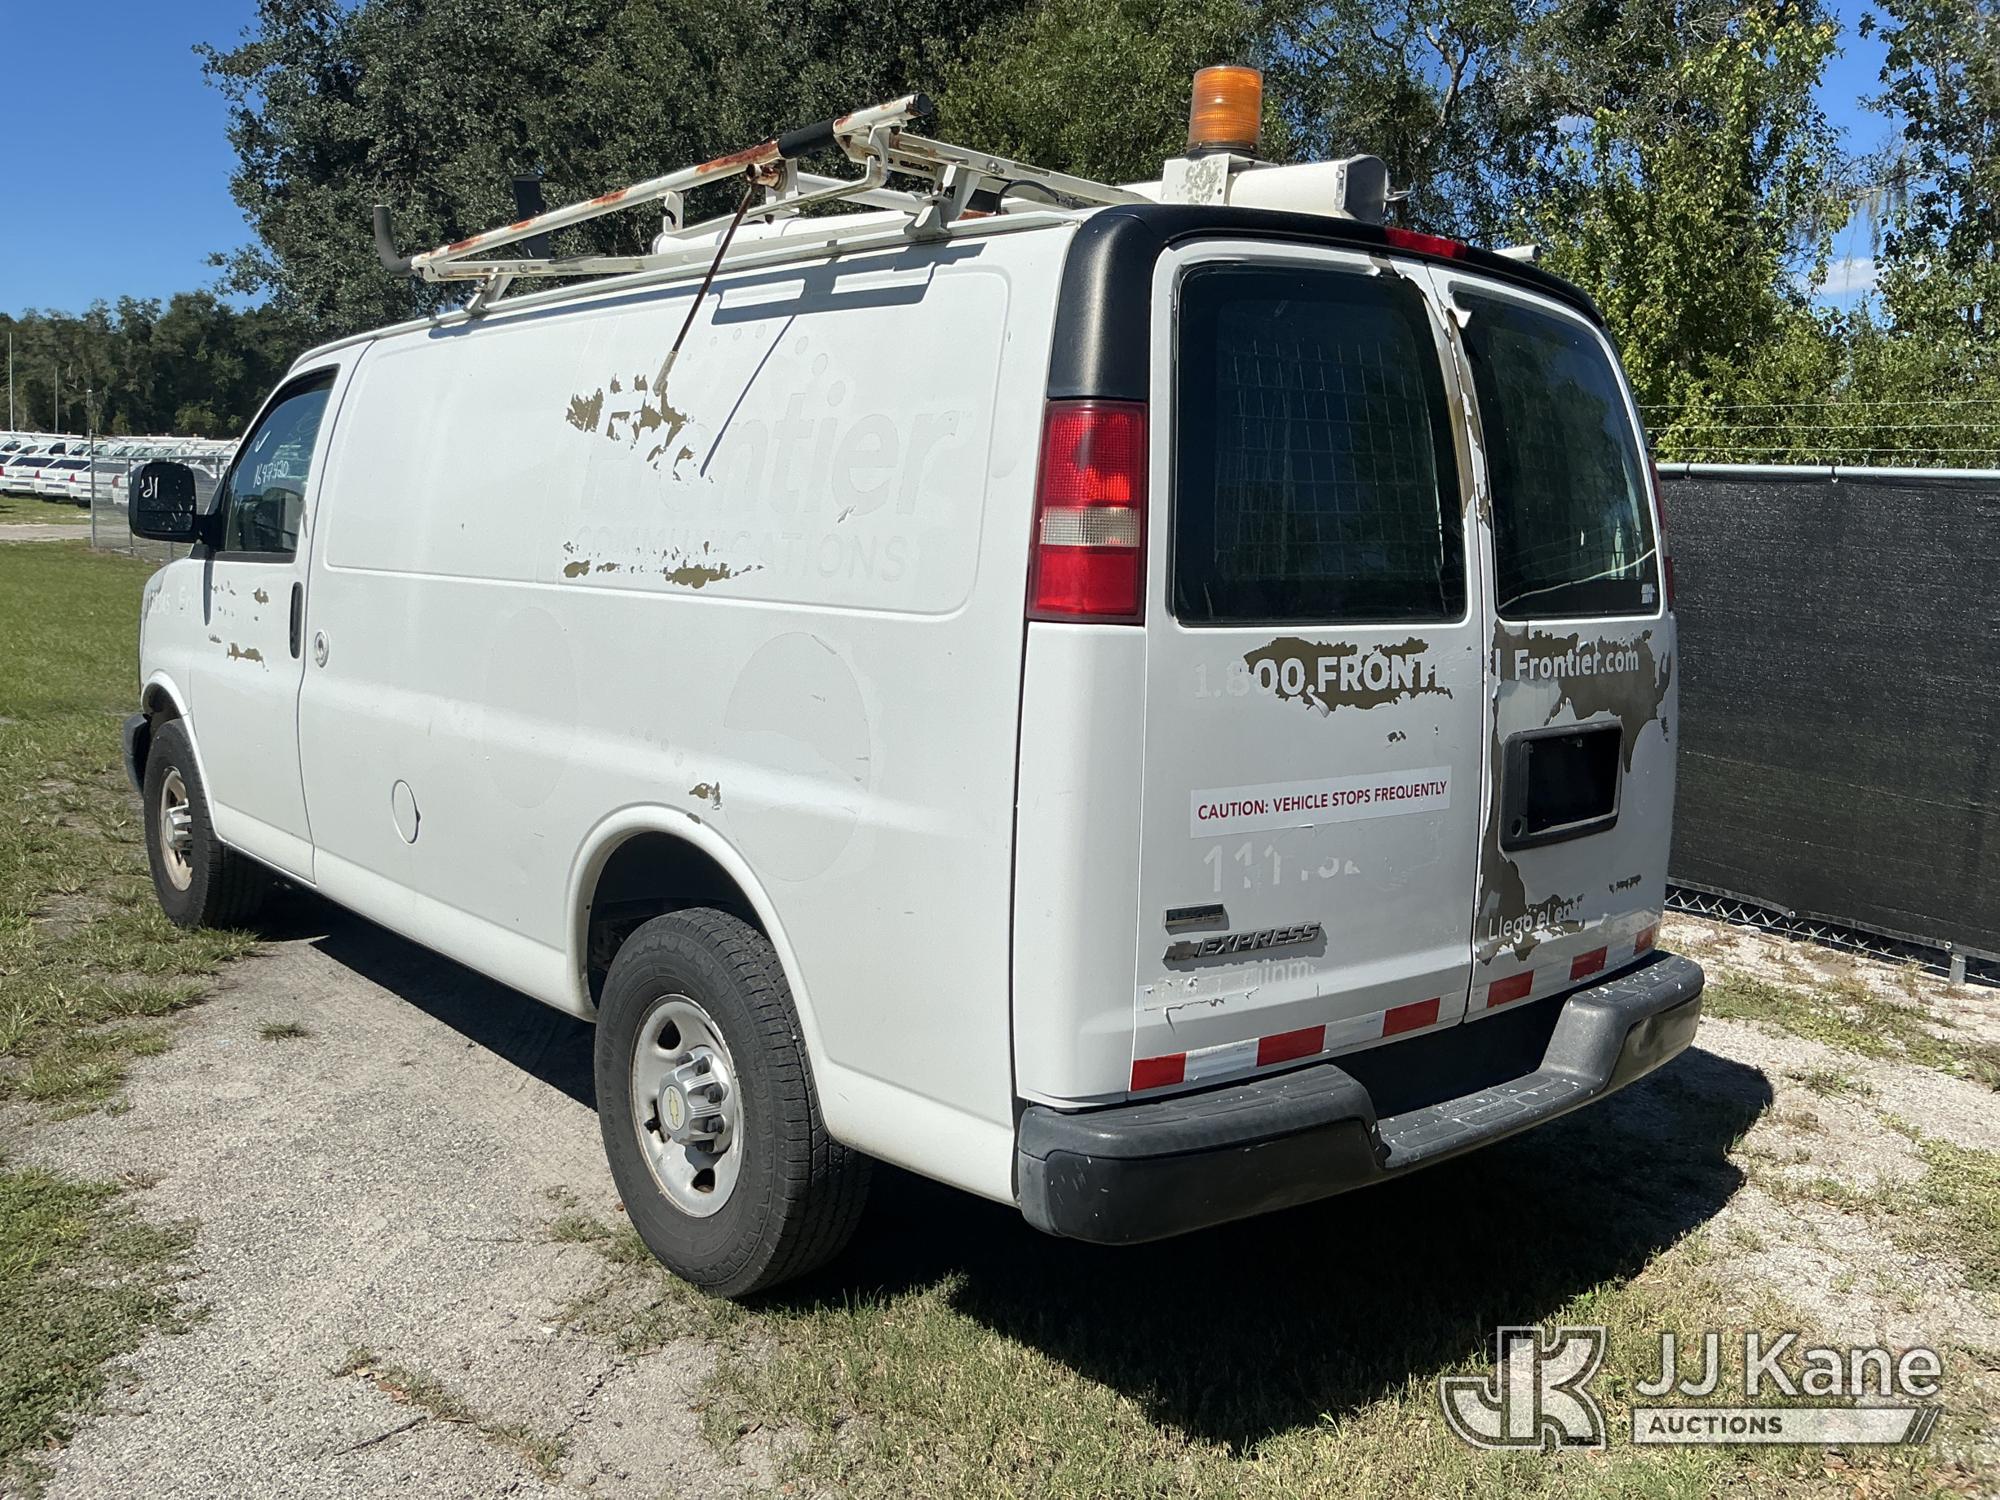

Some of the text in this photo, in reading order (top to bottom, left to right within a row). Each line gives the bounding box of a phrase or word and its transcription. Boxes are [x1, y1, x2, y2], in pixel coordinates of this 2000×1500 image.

[1514, 648, 1640, 681] Frontier.com
[1198, 780, 1448, 821] CAUTION: VEHICLE STOPS FREQUENTLY
[1198, 922, 1322, 958] EXPRESS
